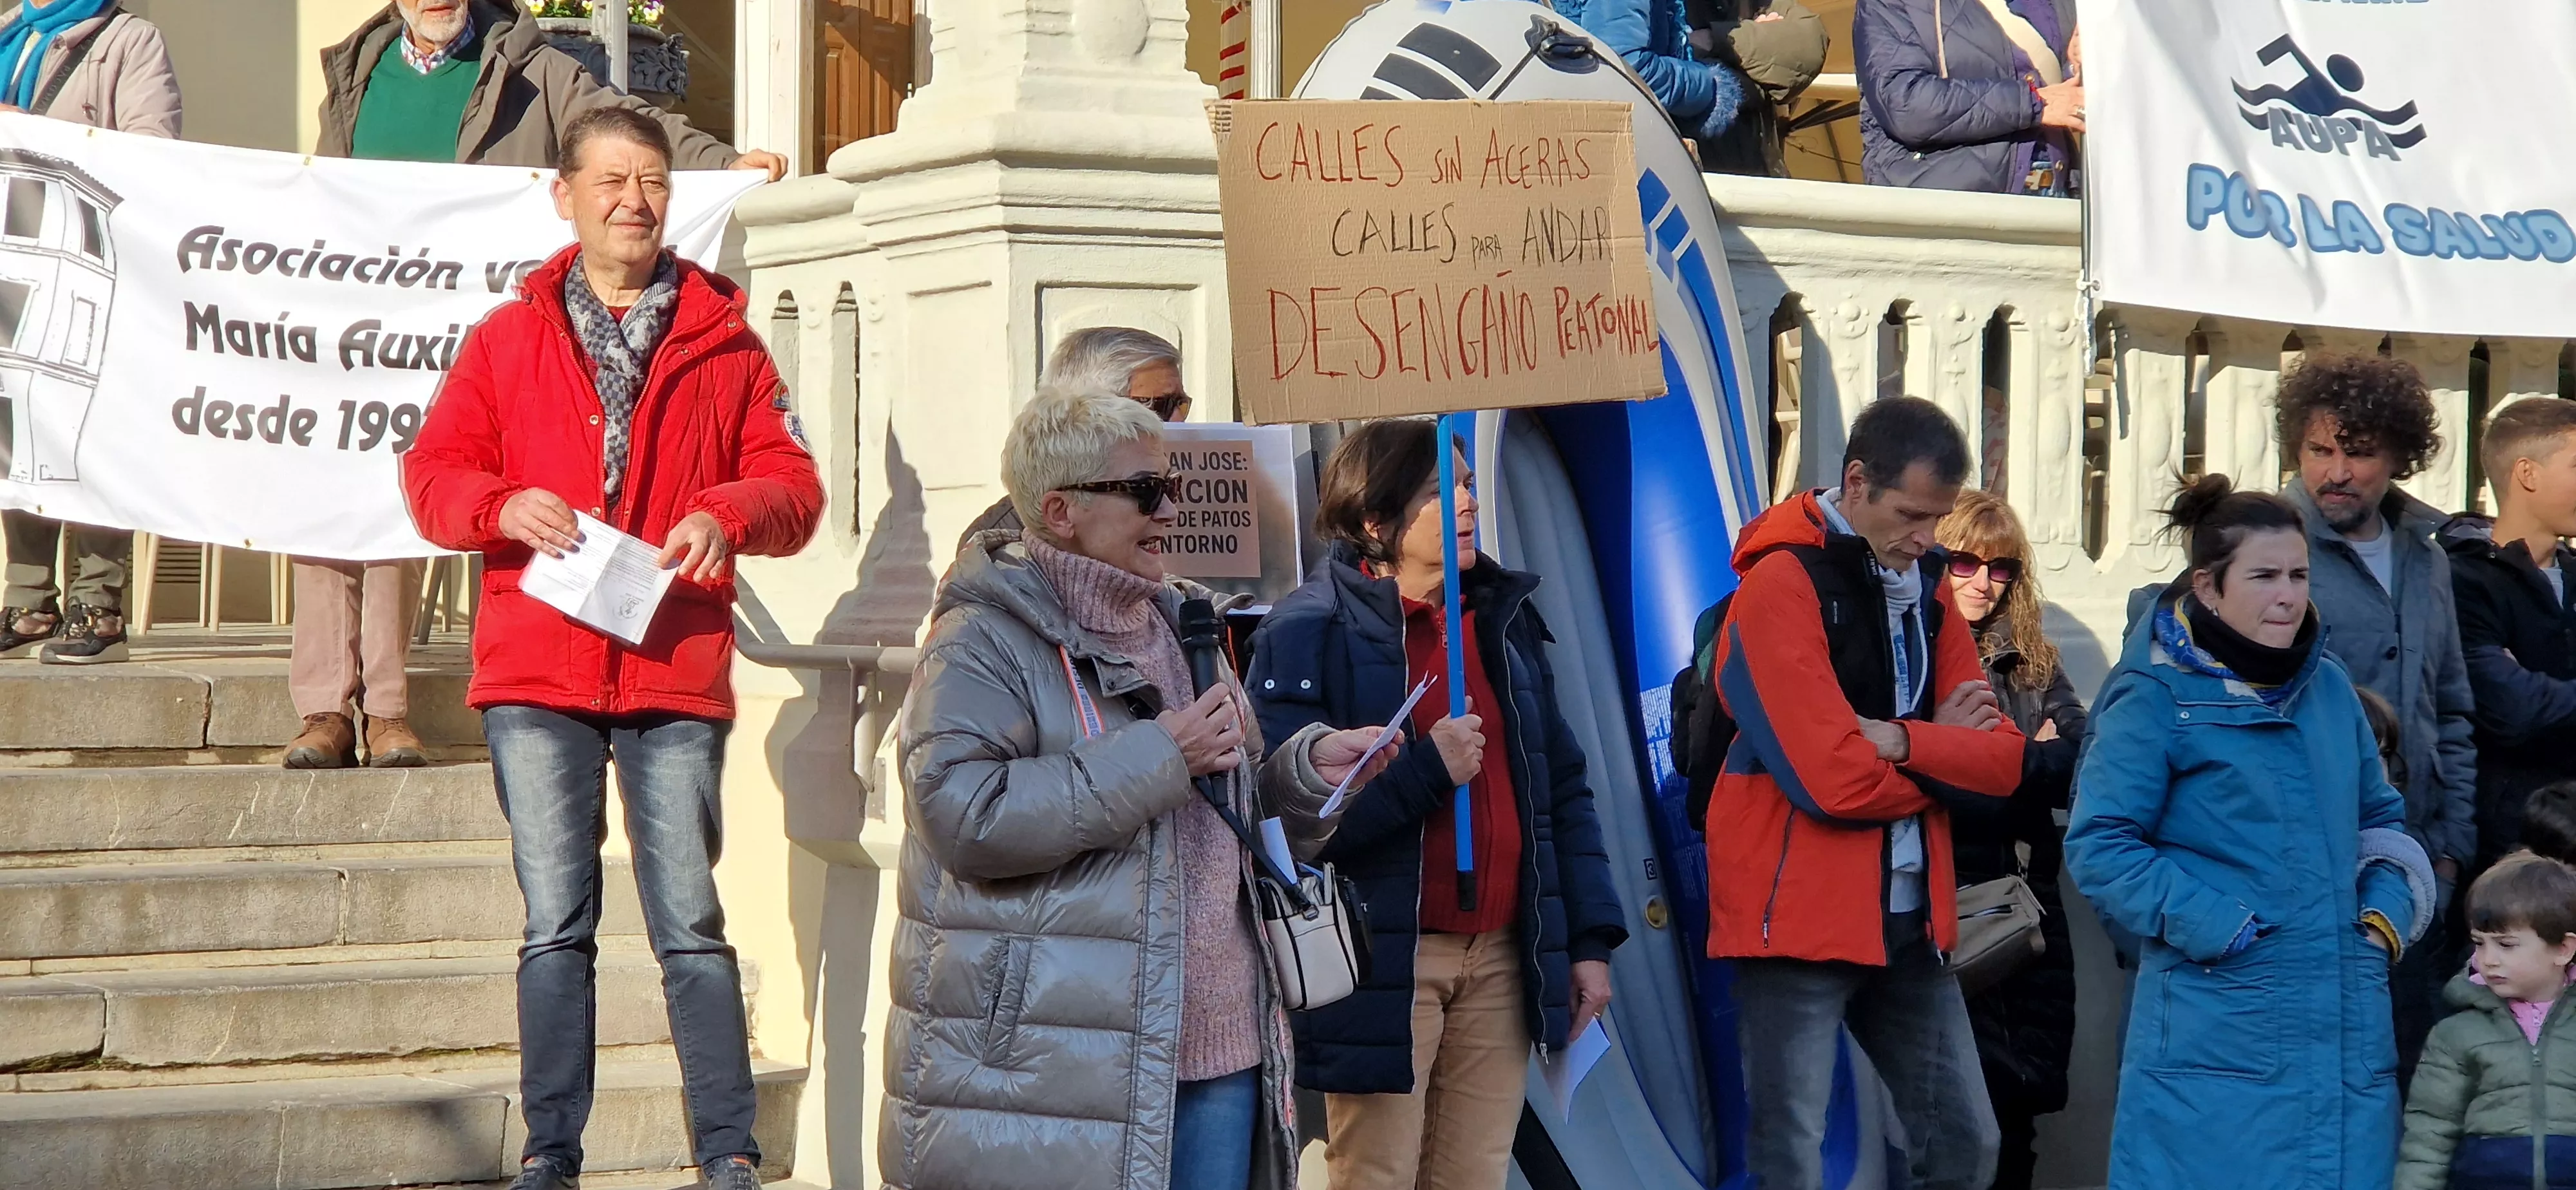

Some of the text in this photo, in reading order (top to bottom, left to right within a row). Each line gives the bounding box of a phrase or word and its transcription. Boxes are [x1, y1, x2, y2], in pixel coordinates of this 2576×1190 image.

[1256, 121, 1591, 189] CALLES SIN ACERAS
[2268, 107, 2401, 161] AUPA
[1331, 202, 1613, 270] CALLES PARA ANDAR
[2187, 163, 2576, 263] POR LA SALUD
[176, 225, 463, 290] Asociación
[183, 300, 478, 372] María Auxi
[1267, 270, 1659, 383] DESENGAÑO PEATONAL
[171, 386, 431, 454] desde 199
[1164, 451, 1248, 471] AN JOSE:
[1179, 479, 1248, 504] CION
[1160, 534, 1238, 554] NTORNO
[1177, 510, 1251, 527] DE PATOS
